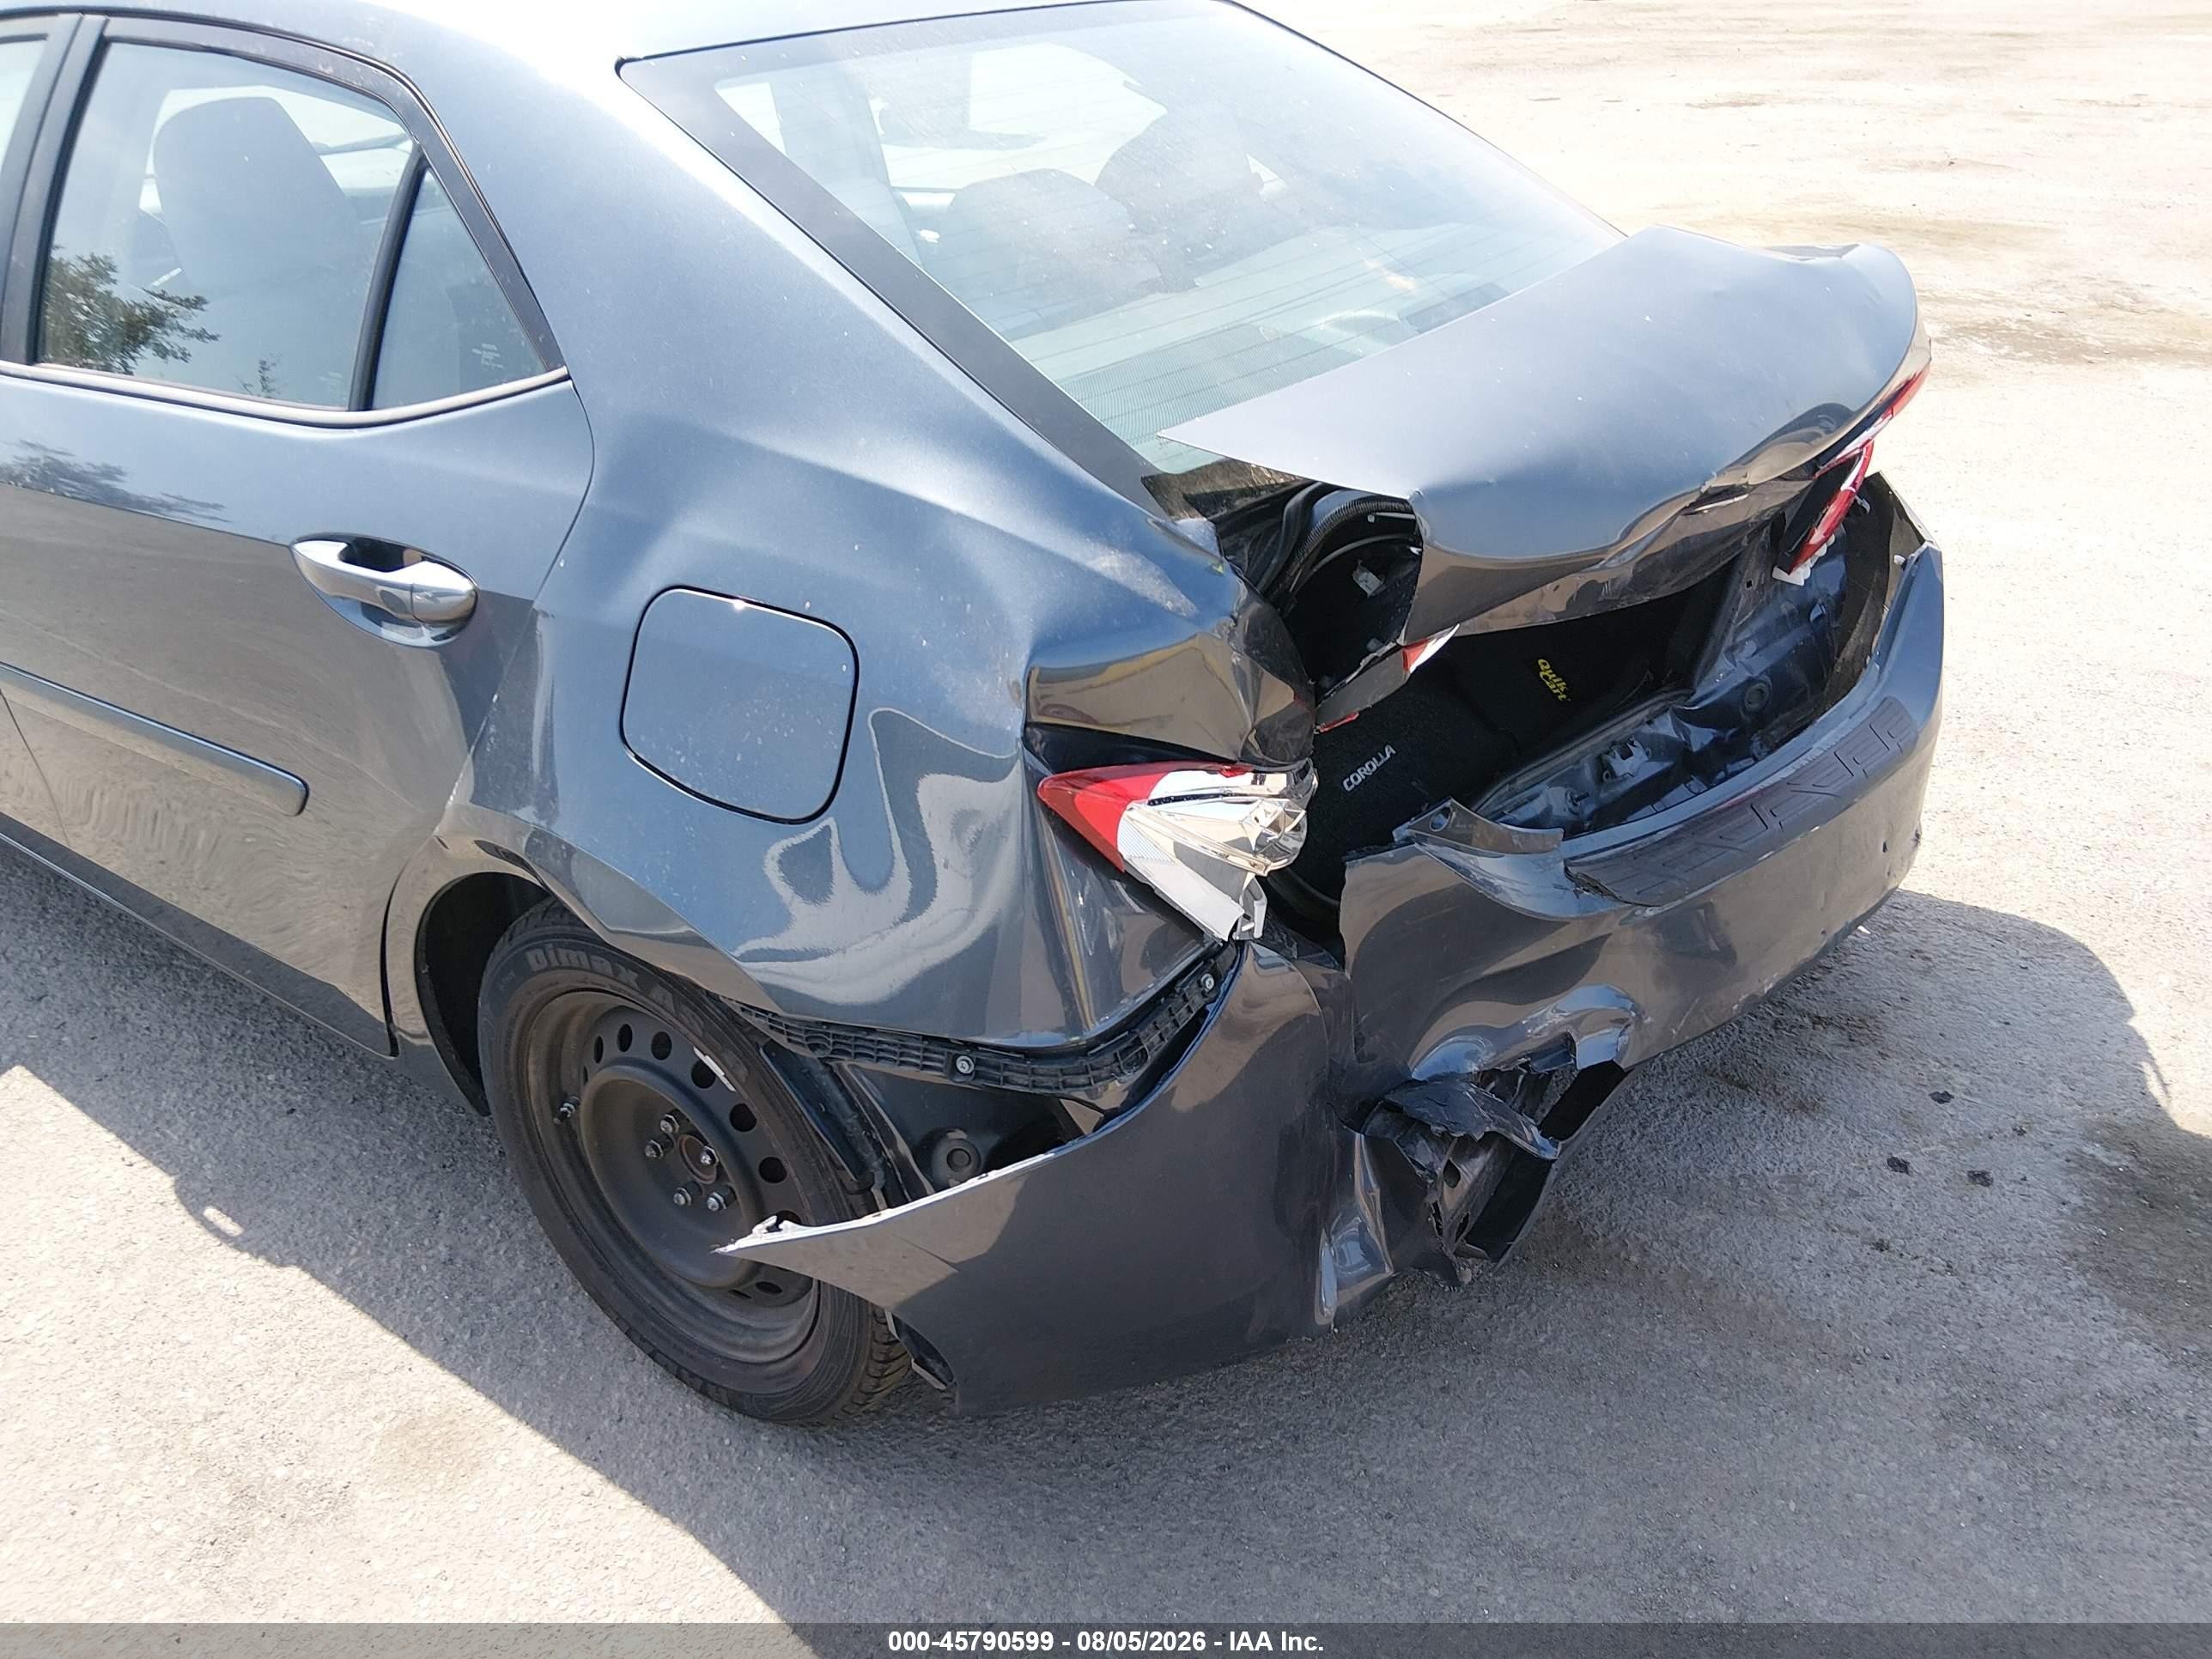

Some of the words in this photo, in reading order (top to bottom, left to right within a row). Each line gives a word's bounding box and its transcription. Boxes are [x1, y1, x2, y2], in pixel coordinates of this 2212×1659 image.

[1538, 659, 1567, 692] Quik
[1540, 672, 1567, 702] Cart
[1343, 744, 1396, 792] COROLLA
